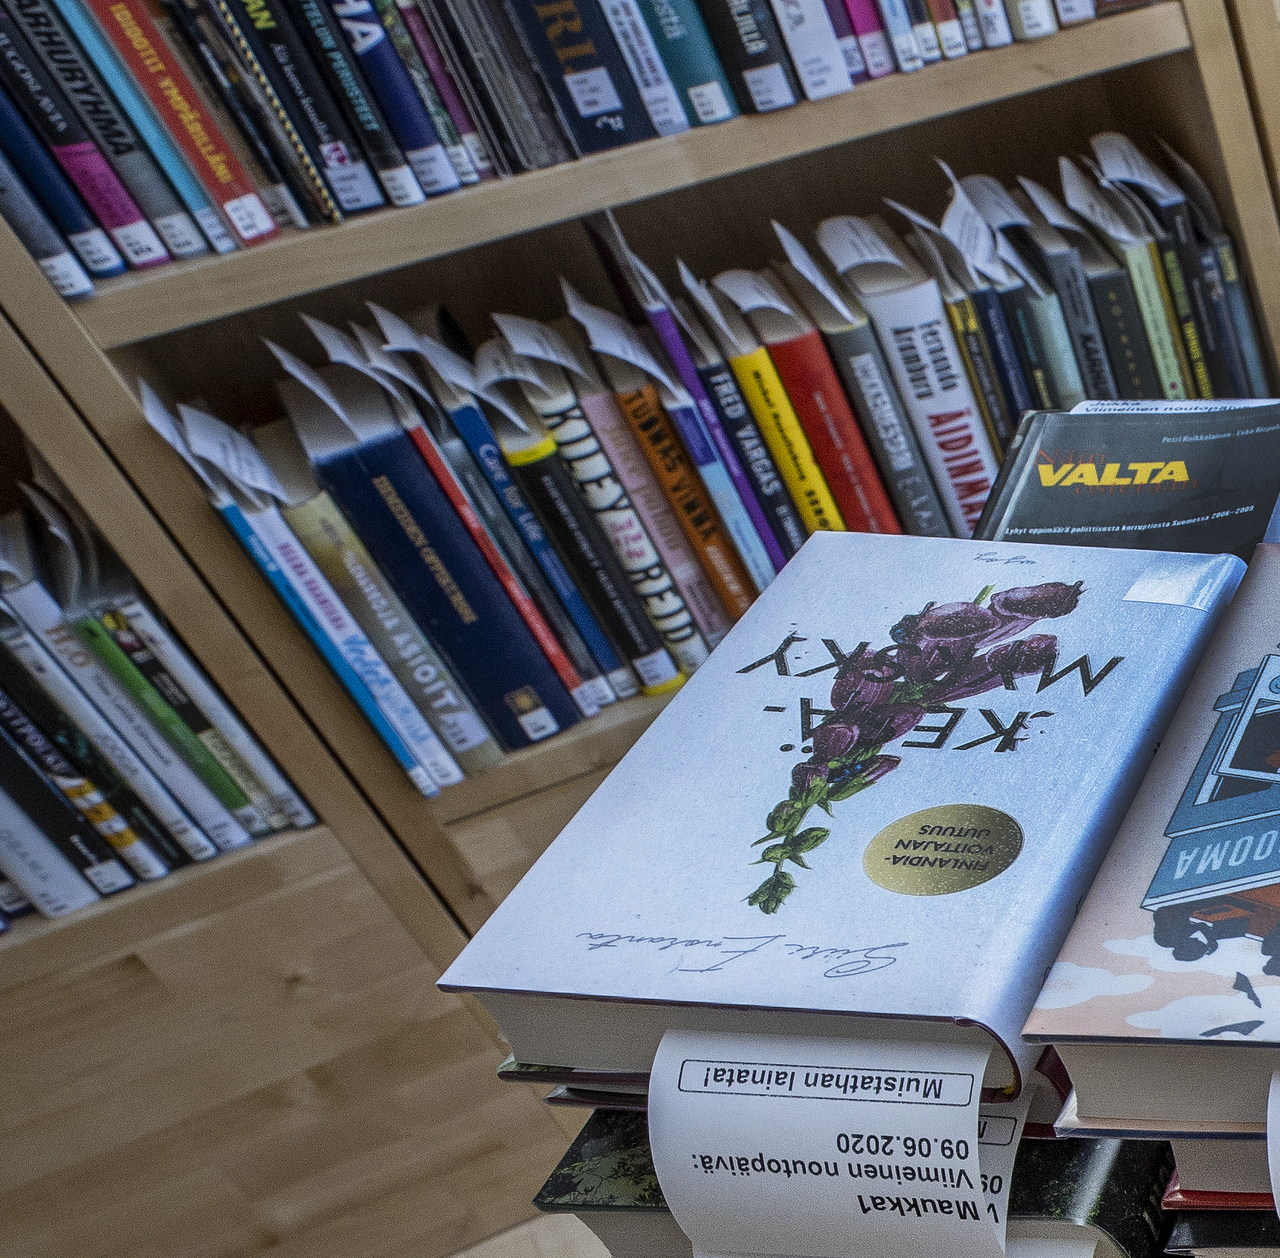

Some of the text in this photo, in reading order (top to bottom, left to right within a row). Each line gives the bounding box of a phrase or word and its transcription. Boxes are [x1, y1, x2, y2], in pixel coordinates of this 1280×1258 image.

[916, 319, 960, 394] Fernando
[709, 371, 787, 497] FRED VARGAS
[1037, 460, 1190, 488] VALTA
[548, 404, 632, 521] KILEY
[631, 563, 697, 645] REID
[894, 836, 1000, 855] VOITTAJAN
[919, 822, 991, 841] UUTUUS
[884, 852, 989, 872] FINLANDIA-
[576, 931, 786, 974] Enoranta
[704, 1067, 943, 1098] Muistathan lainata!
[836, 1133, 969, 1160] 09.06.2020
[692, 1153, 974, 1189] Viimeinen noutopäivä:
[857, 1195, 979, 1221] Maukka1
